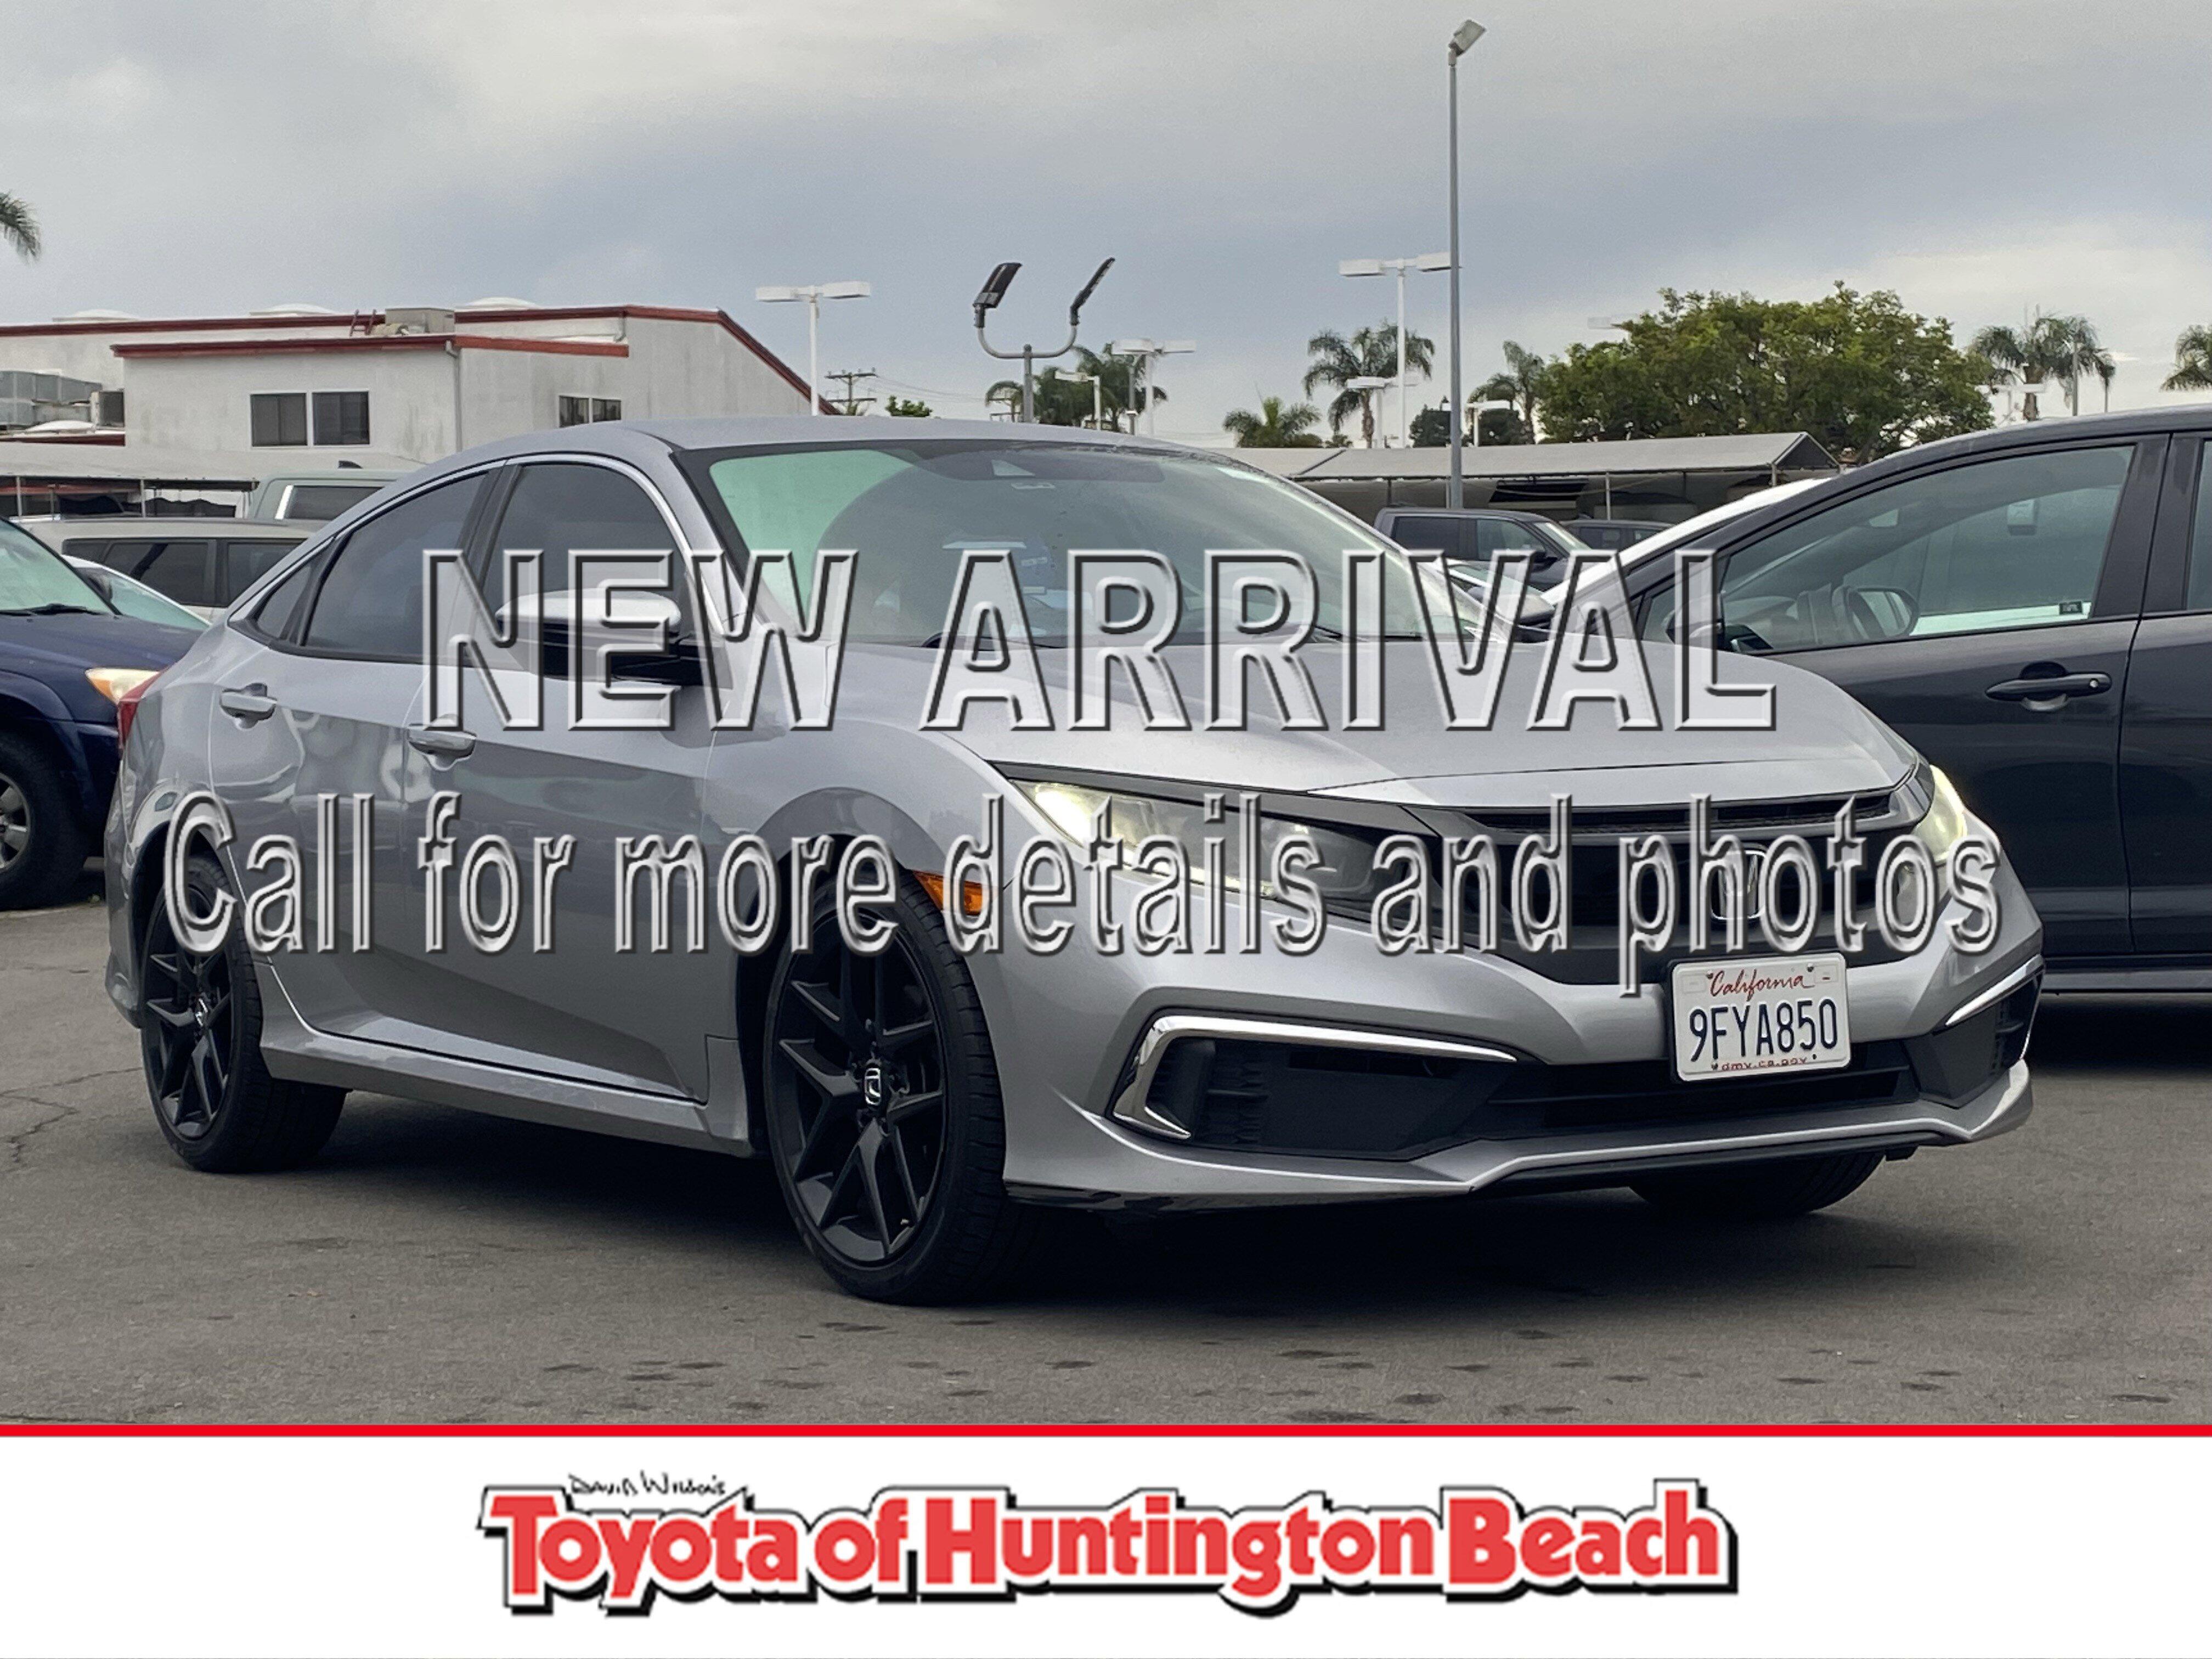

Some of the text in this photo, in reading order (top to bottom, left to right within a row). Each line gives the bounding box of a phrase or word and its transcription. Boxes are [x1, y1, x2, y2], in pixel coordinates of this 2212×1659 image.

[1709, 968, 1815, 1002] California
[1689, 998, 1838, 1062] 9FYA850
[1720, 1056, 1807, 1071] dmv.ca.gov
